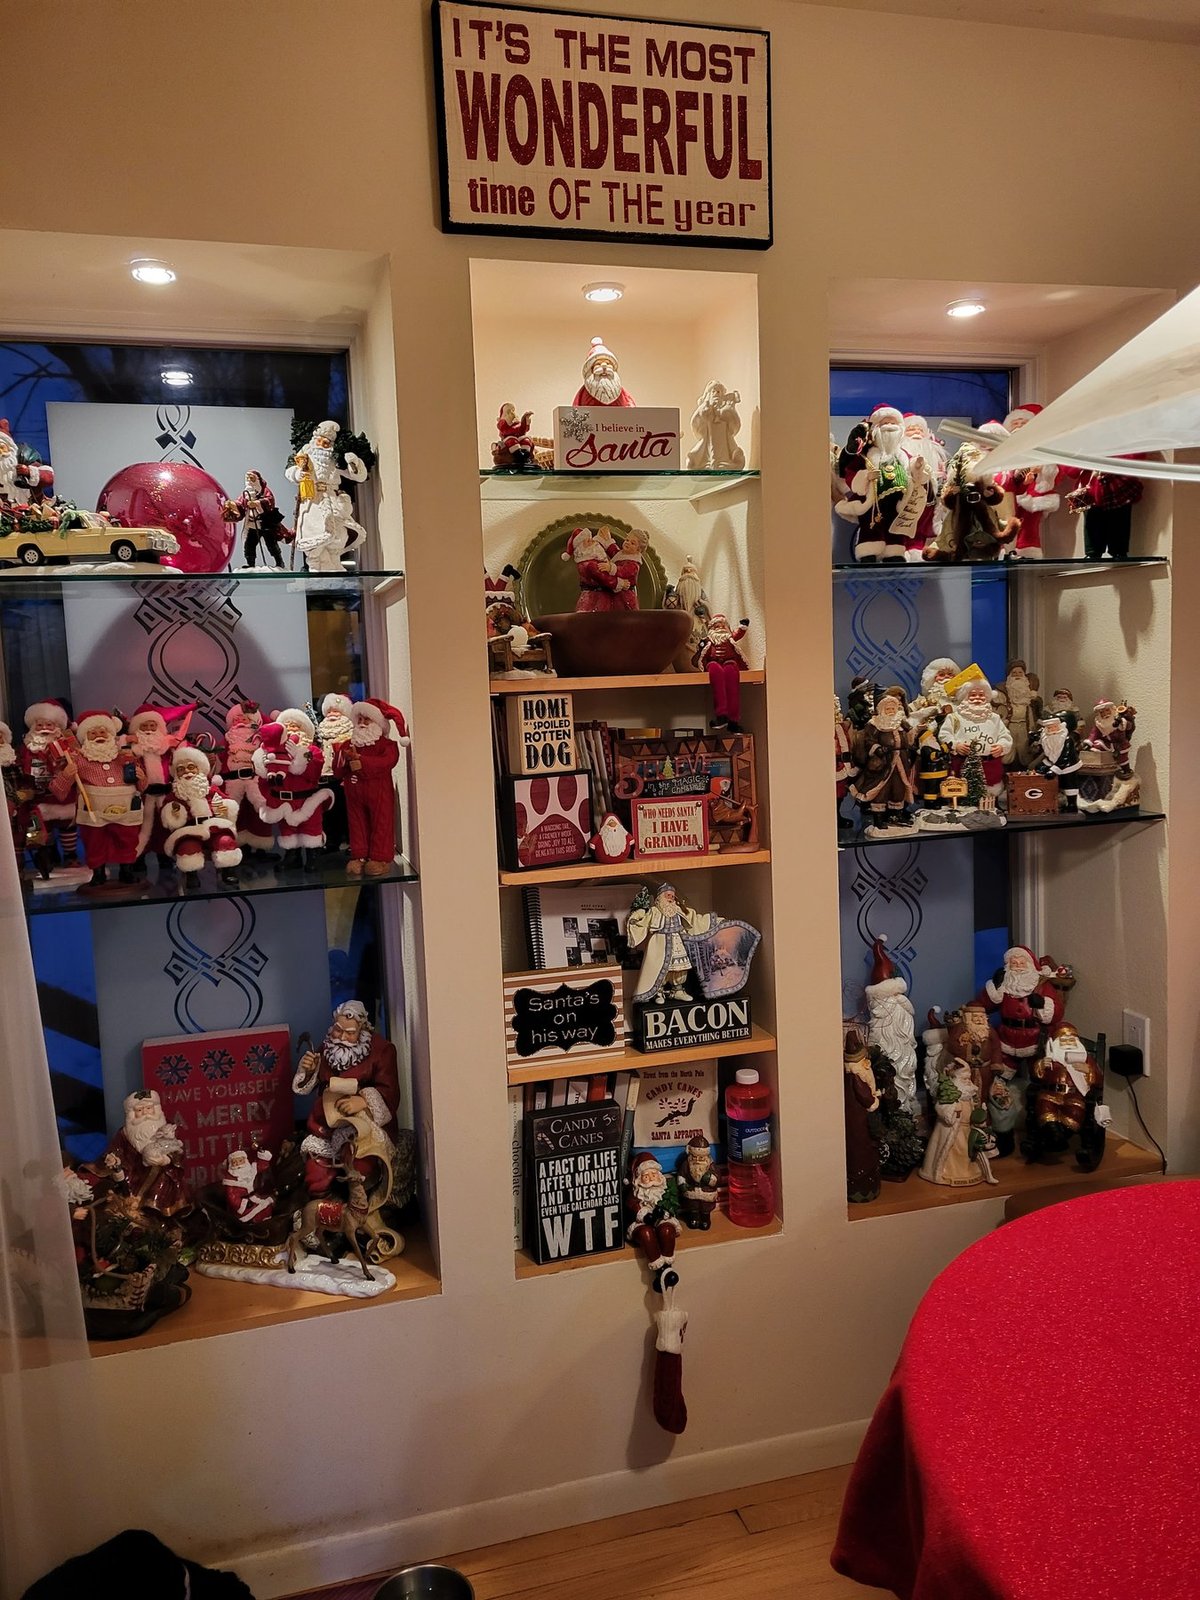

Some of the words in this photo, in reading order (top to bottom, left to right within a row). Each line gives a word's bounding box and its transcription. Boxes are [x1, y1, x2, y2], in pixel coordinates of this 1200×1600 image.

[452, 17, 531, 65] IT'S
[554, 28, 631, 74] THE
[645, 38, 756, 85] MOST
[455, 69, 763, 180] WONDERFUL
[467, 176, 535, 216] time
[549, 177, 591, 221] OF
[601, 180, 665, 225] THE
[674, 198, 756, 232] year
[595, 423, 599, 432] I
[601, 423, 634, 433] believe
[635, 423, 645, 433] in
[565, 431, 677, 468] Santa
[523, 697, 570, 720] HOME
[524, 729, 571, 743] ROTTEN
[533, 719, 571, 730] SPOILED
[525, 741, 573, 770] DOG
[1024, 788, 1043, 799] G
[642, 806, 657, 819] WHO
[658, 806, 676, 817] NEEDS
[677, 805, 698, 817] SANTA?
[652, 821, 658, 833] I
[661, 820, 689, 833] HAVE
[644, 834, 698, 849] GRANDMA
[528, 990, 600, 1012] Santa's
[553, 1012, 577, 1025] on
[645, 1000, 748, 1039] BACON
[531, 1028, 558, 1045] his
[561, 1025, 599, 1041] way
[646, 1038, 672, 1050] MAKES
[674, 1030, 720, 1046] EVERYTHING
[721, 1027, 749, 1039] BETTER
[162, 1088, 201, 1105] HAVE
[206, 1078, 280, 1098] YOURSELF
[645, 1082, 673, 1100] CANDY
[677, 1082, 703, 1098] CANES
[172, 1111, 188, 1130] A
[196, 1100, 276, 1129] MERRY
[550, 1117, 598, 1134] CANDY
[185, 1129, 264, 1159] LITTLE
[558, 1131, 604, 1149] CANES
[651, 1131, 671, 1140] SANTA
[511, 1140, 522, 1197] chocolate
[539, 1162, 547, 1179] A
[549, 1157, 575, 1177] FACT
[578, 1154, 591, 1172] OF
[594, 1150, 617, 1169] LIFE
[540, 1175, 572, 1194] AFTER
[575, 1165, 618, 1187] MONDAY
[540, 1189, 564, 1208] AND
[568, 1180, 619, 1203] TUESDAY
[541, 1205, 558, 1218] EVEN
[558, 1203, 571, 1214] THE
[571, 1197, 603, 1212] CALENDAR
[603, 1194, 620, 1206] SAYS
[542, 1205, 619, 1259] WTF
